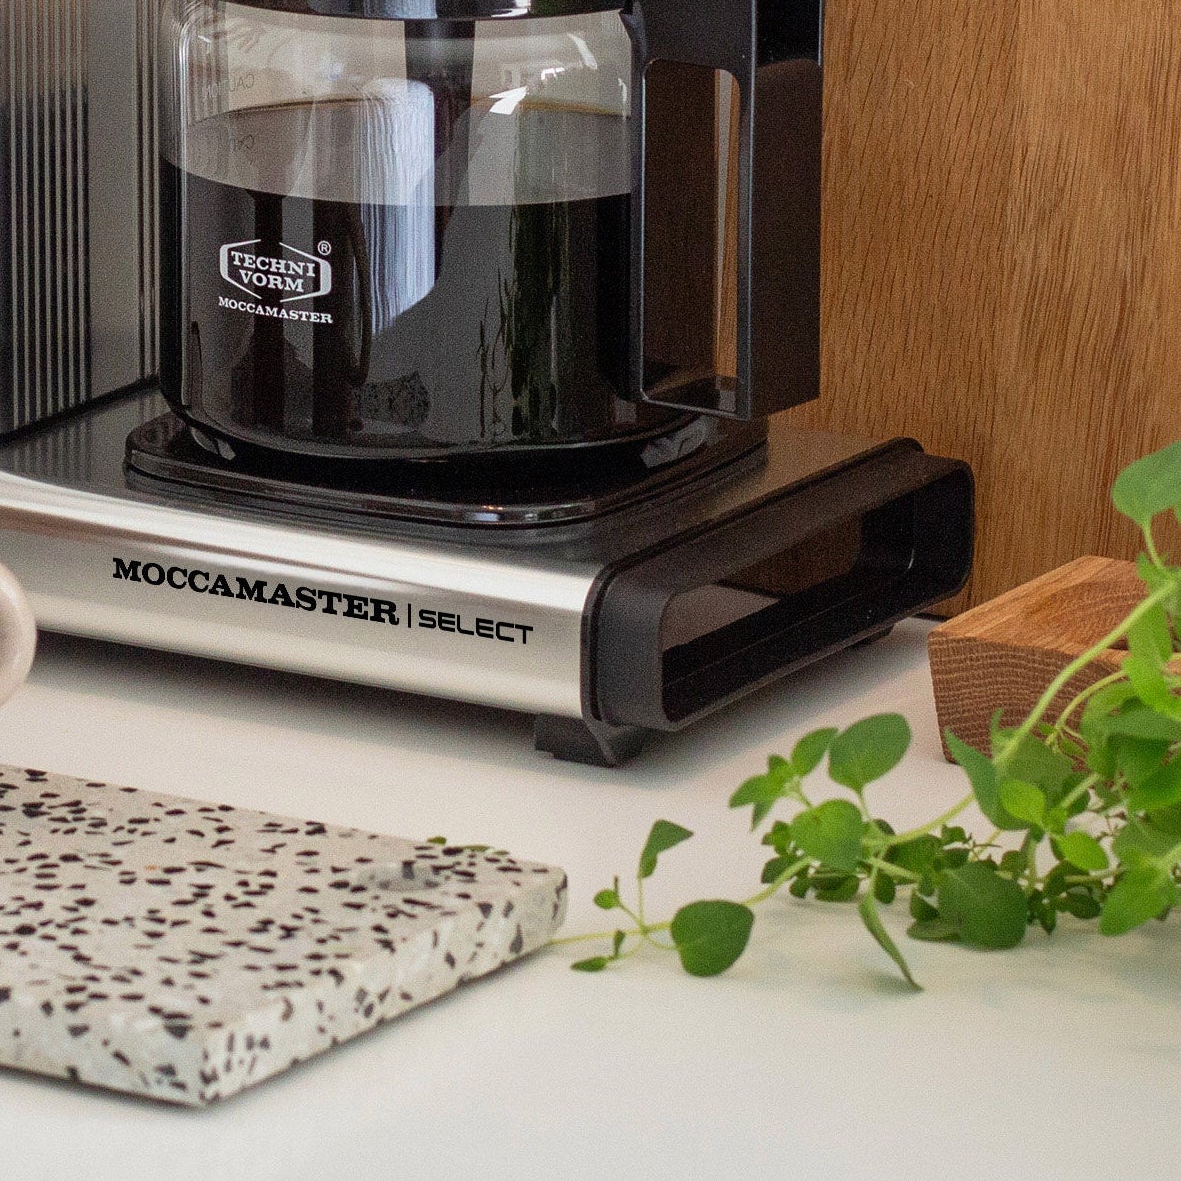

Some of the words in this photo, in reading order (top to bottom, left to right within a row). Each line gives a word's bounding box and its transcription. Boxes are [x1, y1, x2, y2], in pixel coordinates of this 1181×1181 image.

[231, 251, 316, 277] TECHNI
[239, 269, 304, 293] VORM
[218, 296, 333, 324] MOCCAMASTER
[112, 557, 400, 627] MOCCAMASTER
[419, 609, 534, 645] SELECT
